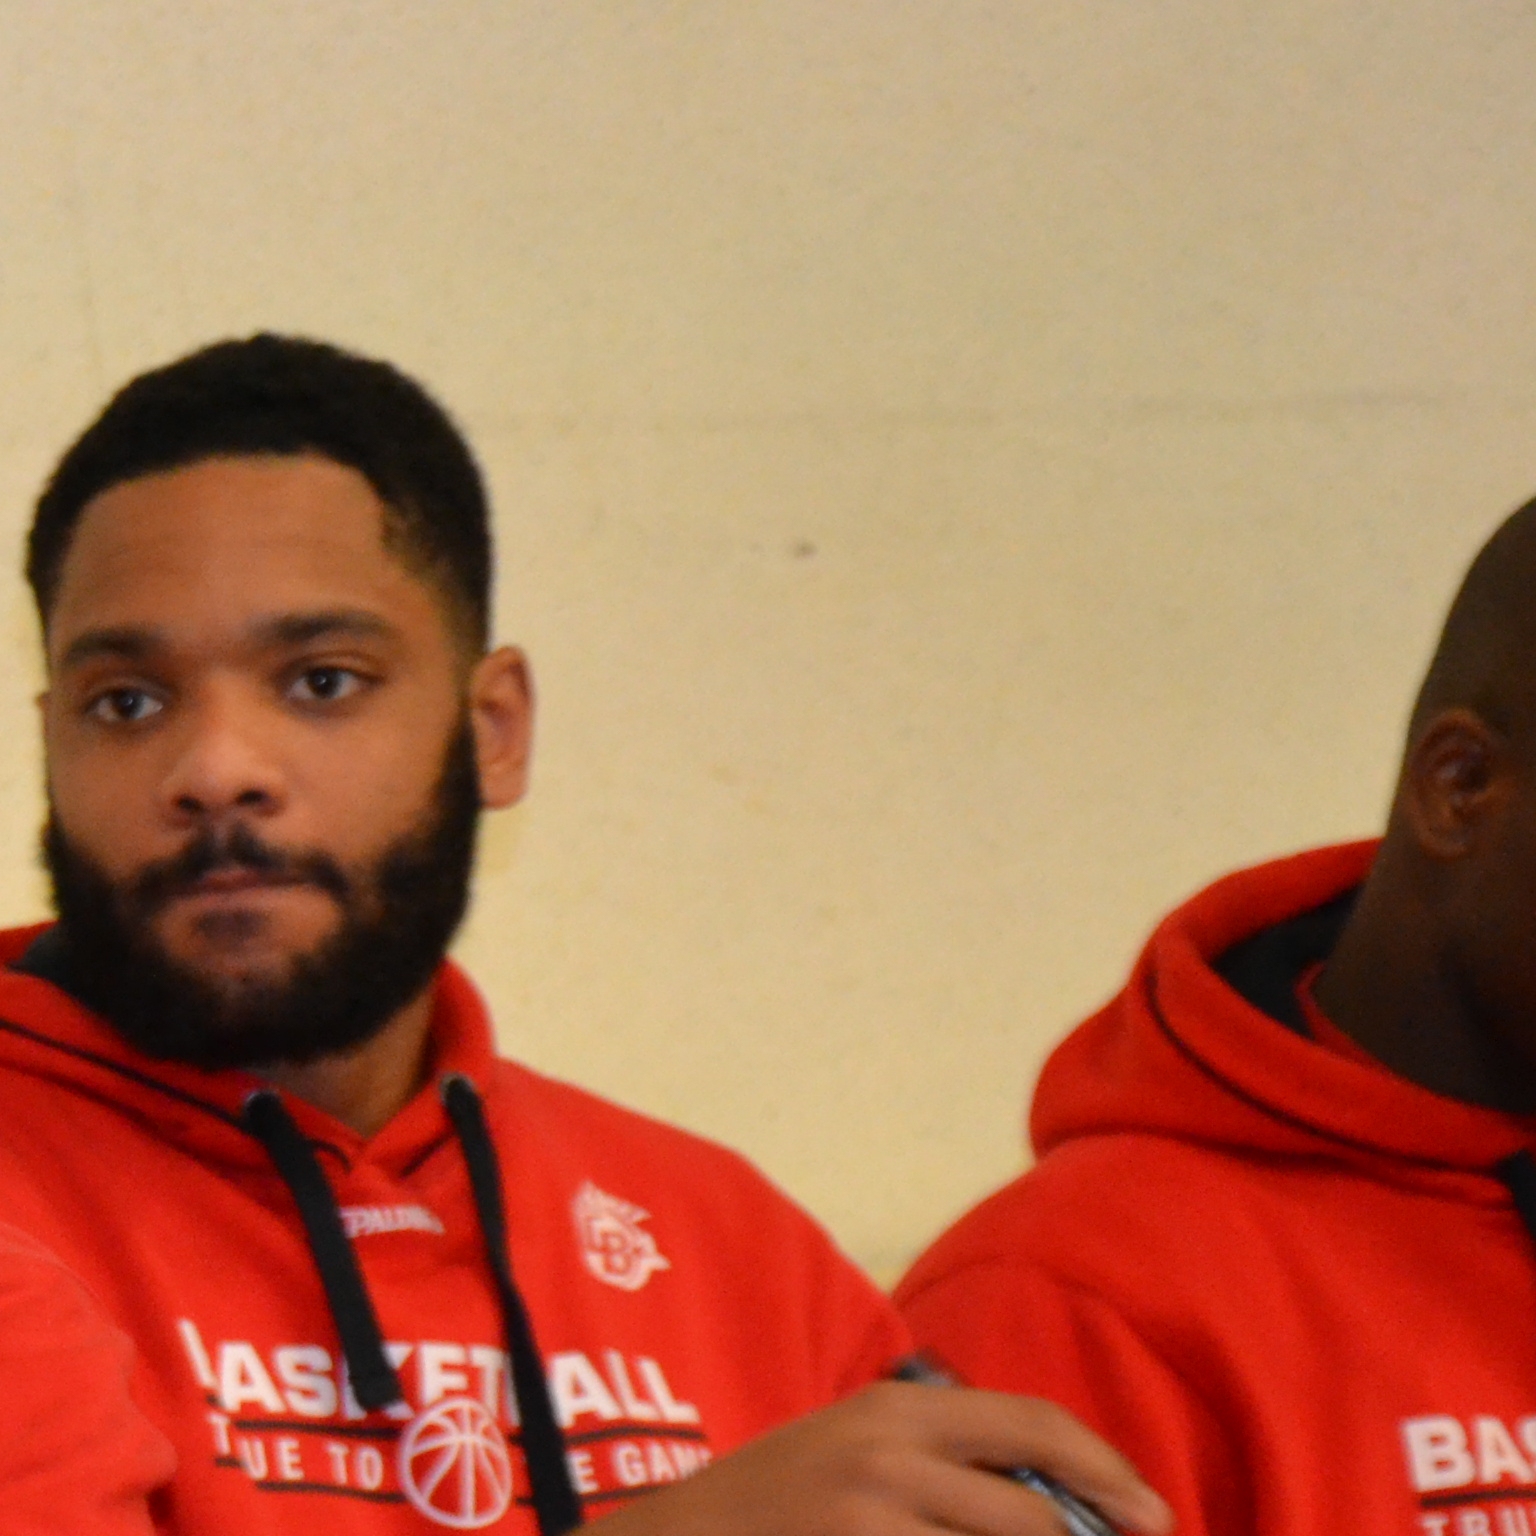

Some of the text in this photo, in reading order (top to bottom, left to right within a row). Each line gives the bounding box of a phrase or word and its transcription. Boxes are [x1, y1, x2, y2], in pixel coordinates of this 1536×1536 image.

[178, 1316, 701, 1421] ASETALL
[208, 1410, 384, 1492] TUE TO
